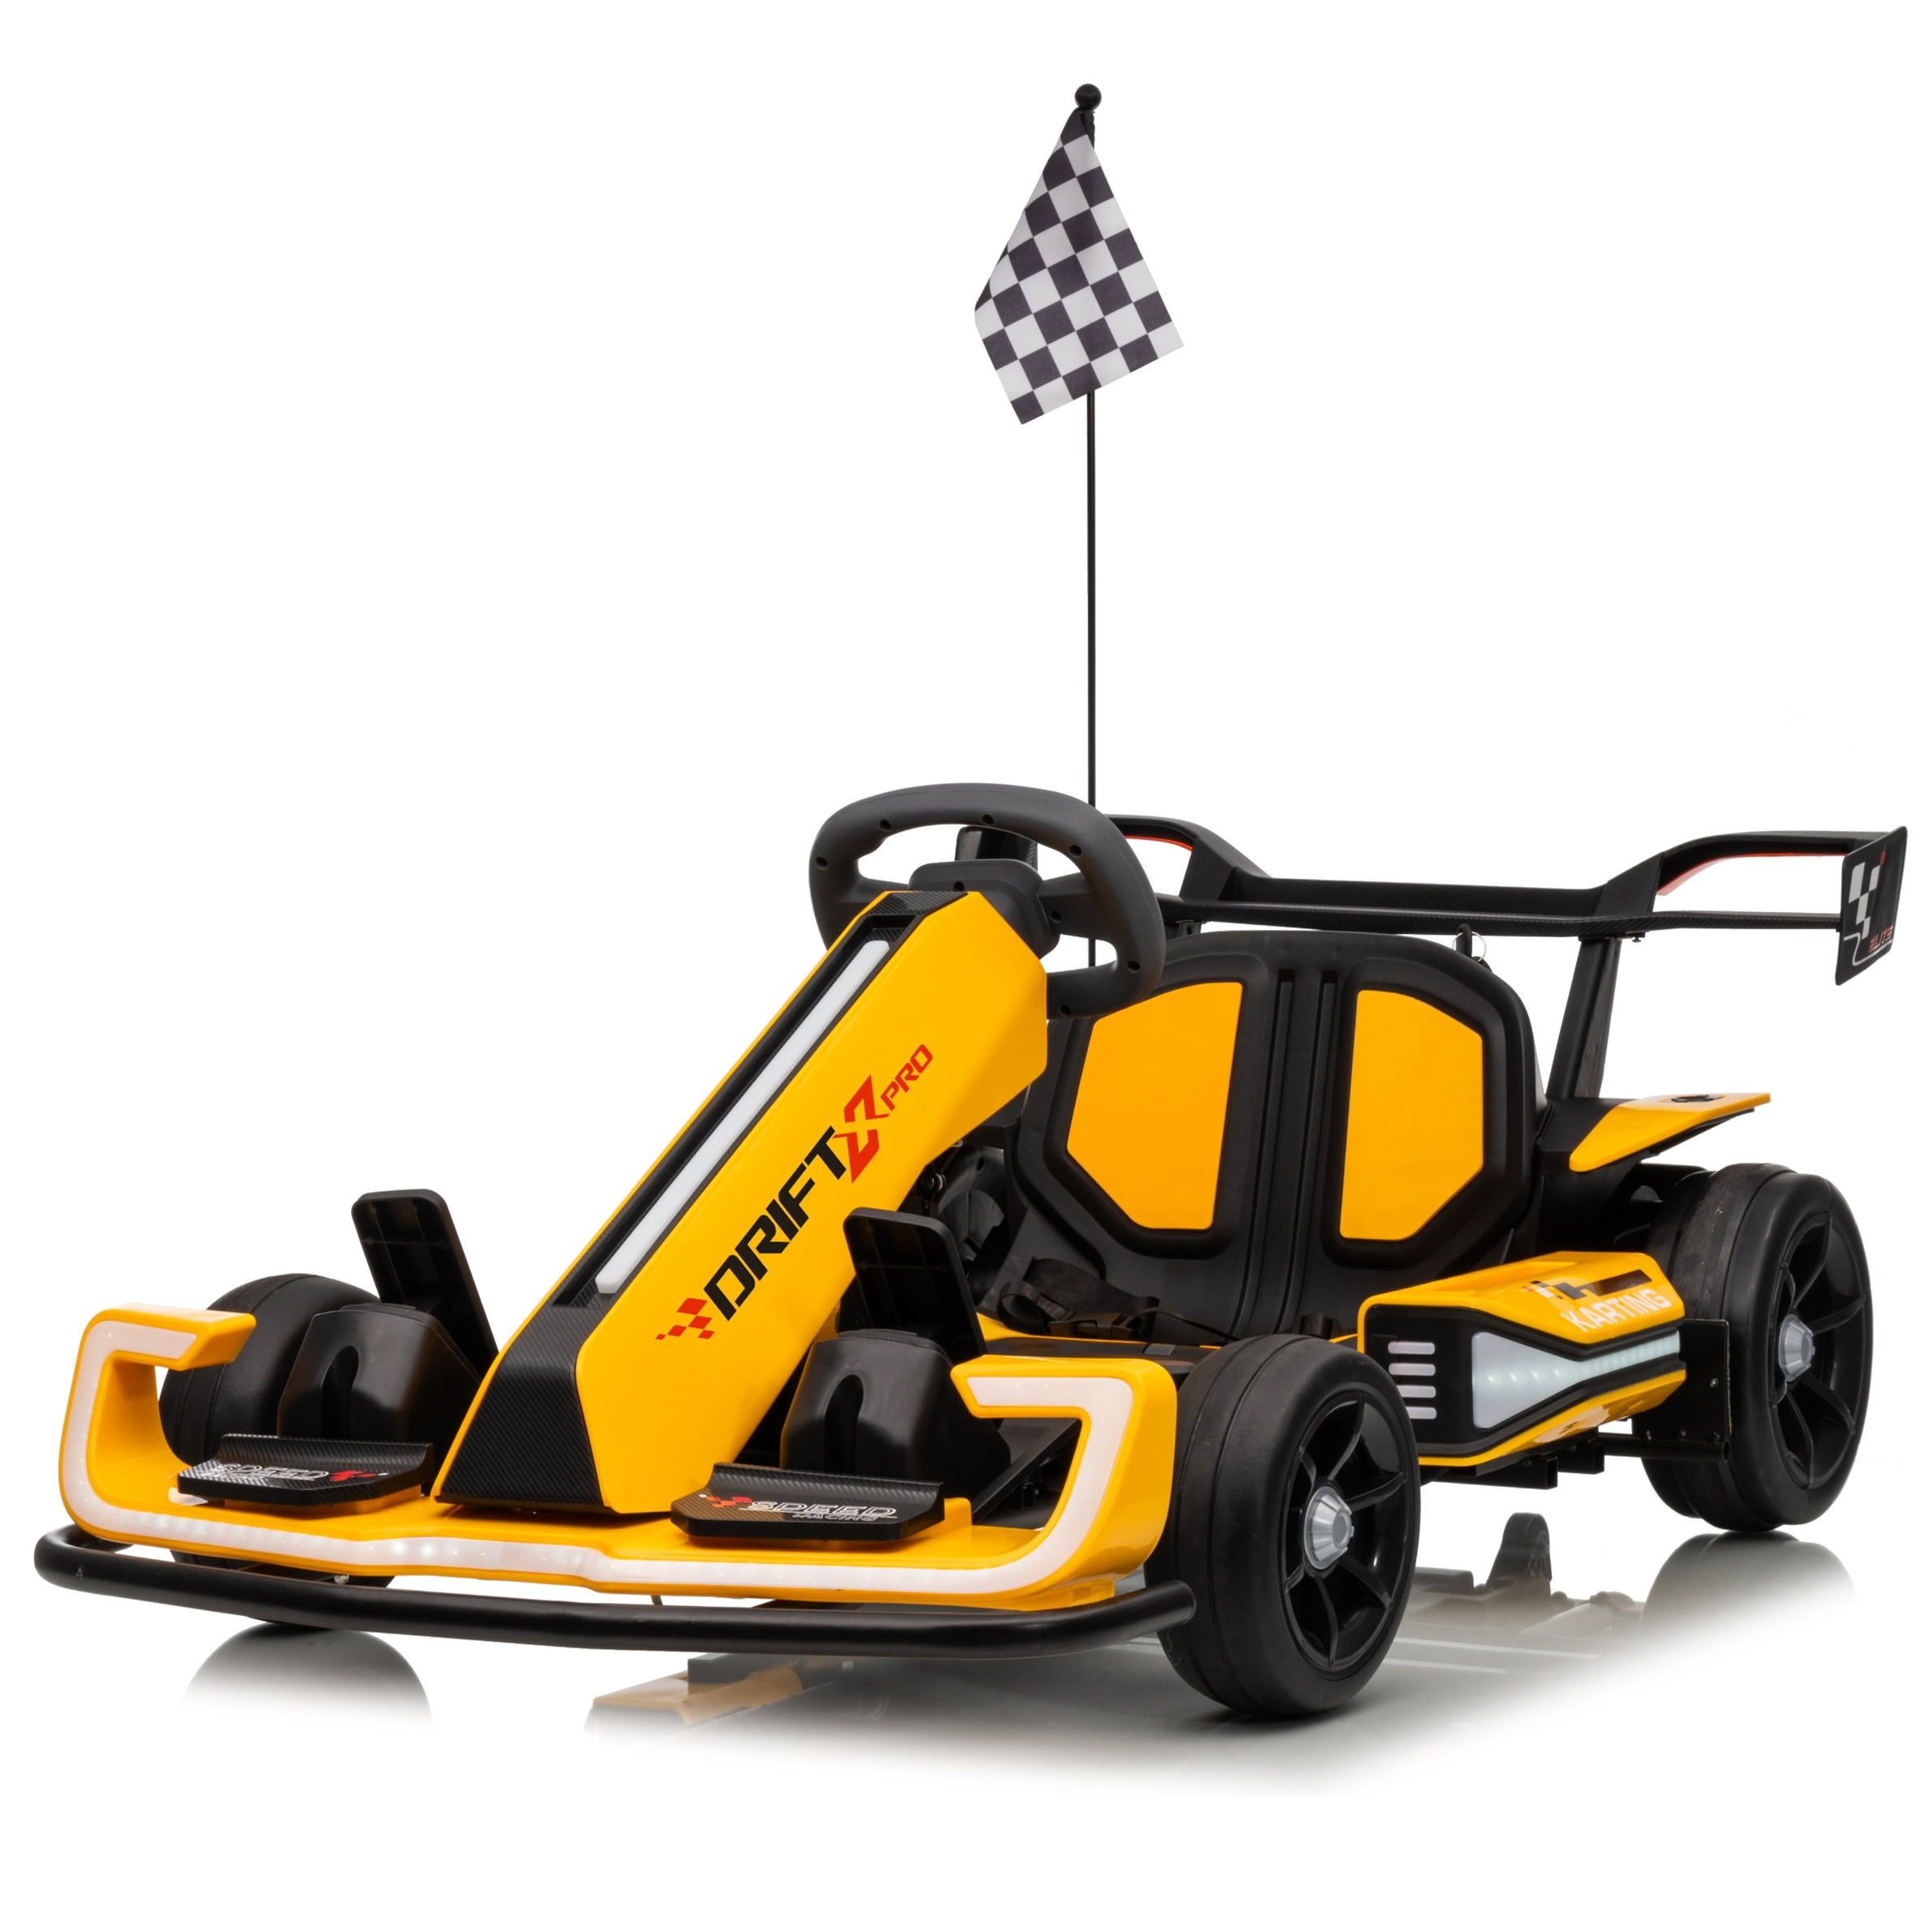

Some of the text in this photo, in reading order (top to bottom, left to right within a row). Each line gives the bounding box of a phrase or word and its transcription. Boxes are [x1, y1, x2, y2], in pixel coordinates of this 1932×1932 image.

[880, 1043, 933, 1112] PRO
[1559, 1288, 1672, 1332] KARTING
[746, 1501, 897, 1516] SPEED
